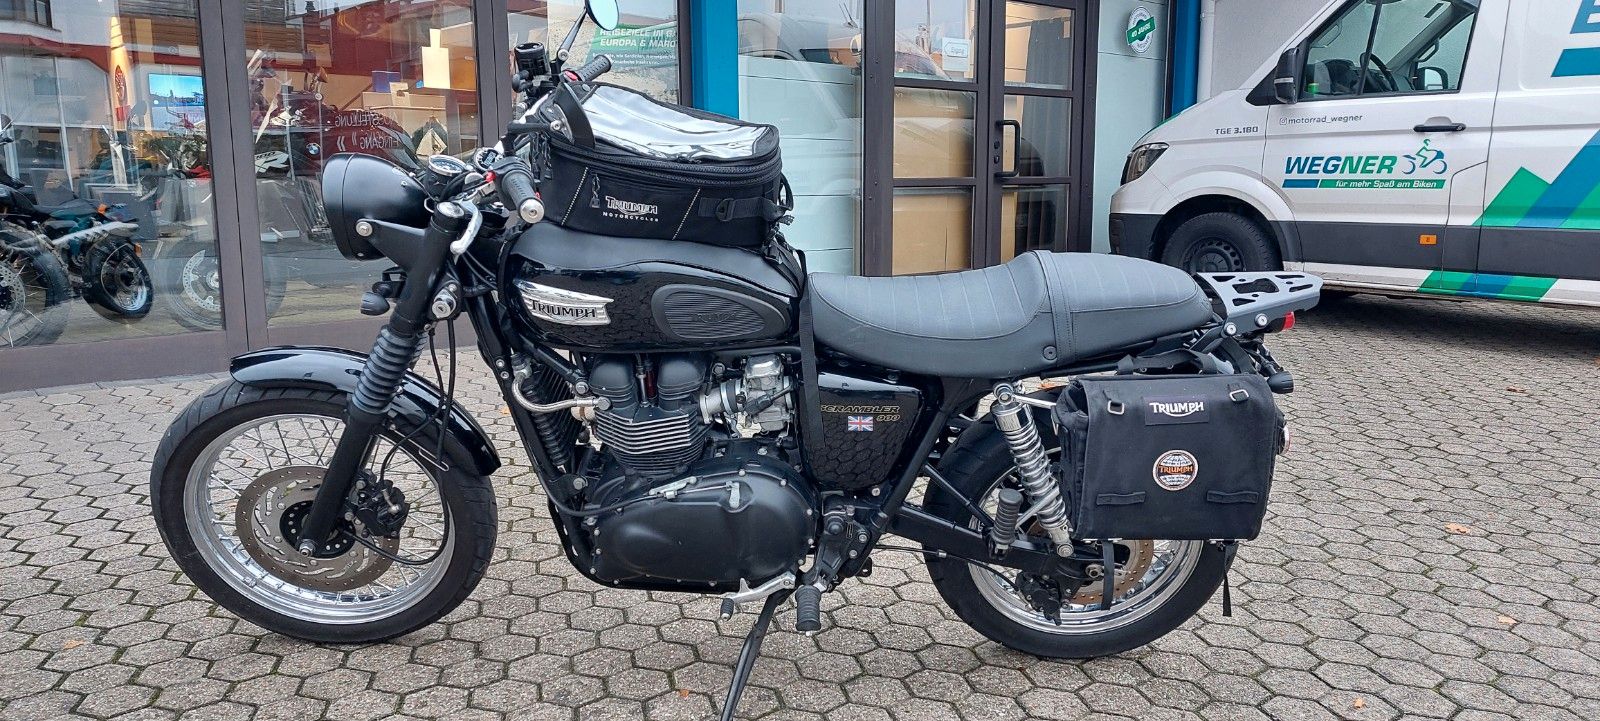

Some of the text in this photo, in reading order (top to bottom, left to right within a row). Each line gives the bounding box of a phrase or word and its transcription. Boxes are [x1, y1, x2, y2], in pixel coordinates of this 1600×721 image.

[653, 29, 663, 37] IN
[600, 38, 637, 47] EUROPA
[1288, 115, 1363, 125] motorrad_wegner
[1215, 126, 1259, 135] TGE 3.180
[1285, 155, 1398, 174] WEGNER
[1335, 179, 1347, 188] für
[1350, 179, 1372, 188] mehr
[1373, 180, 1395, 189] Spaß
[1413, 180, 1437, 188] Biken
[605, 196, 658, 215] TRIUMPH
[529, 298, 597, 319] TRIUMPH
[1149, 401, 1205, 417] TRIUMPH
[1158, 463, 1194, 475] TRIUMPH
